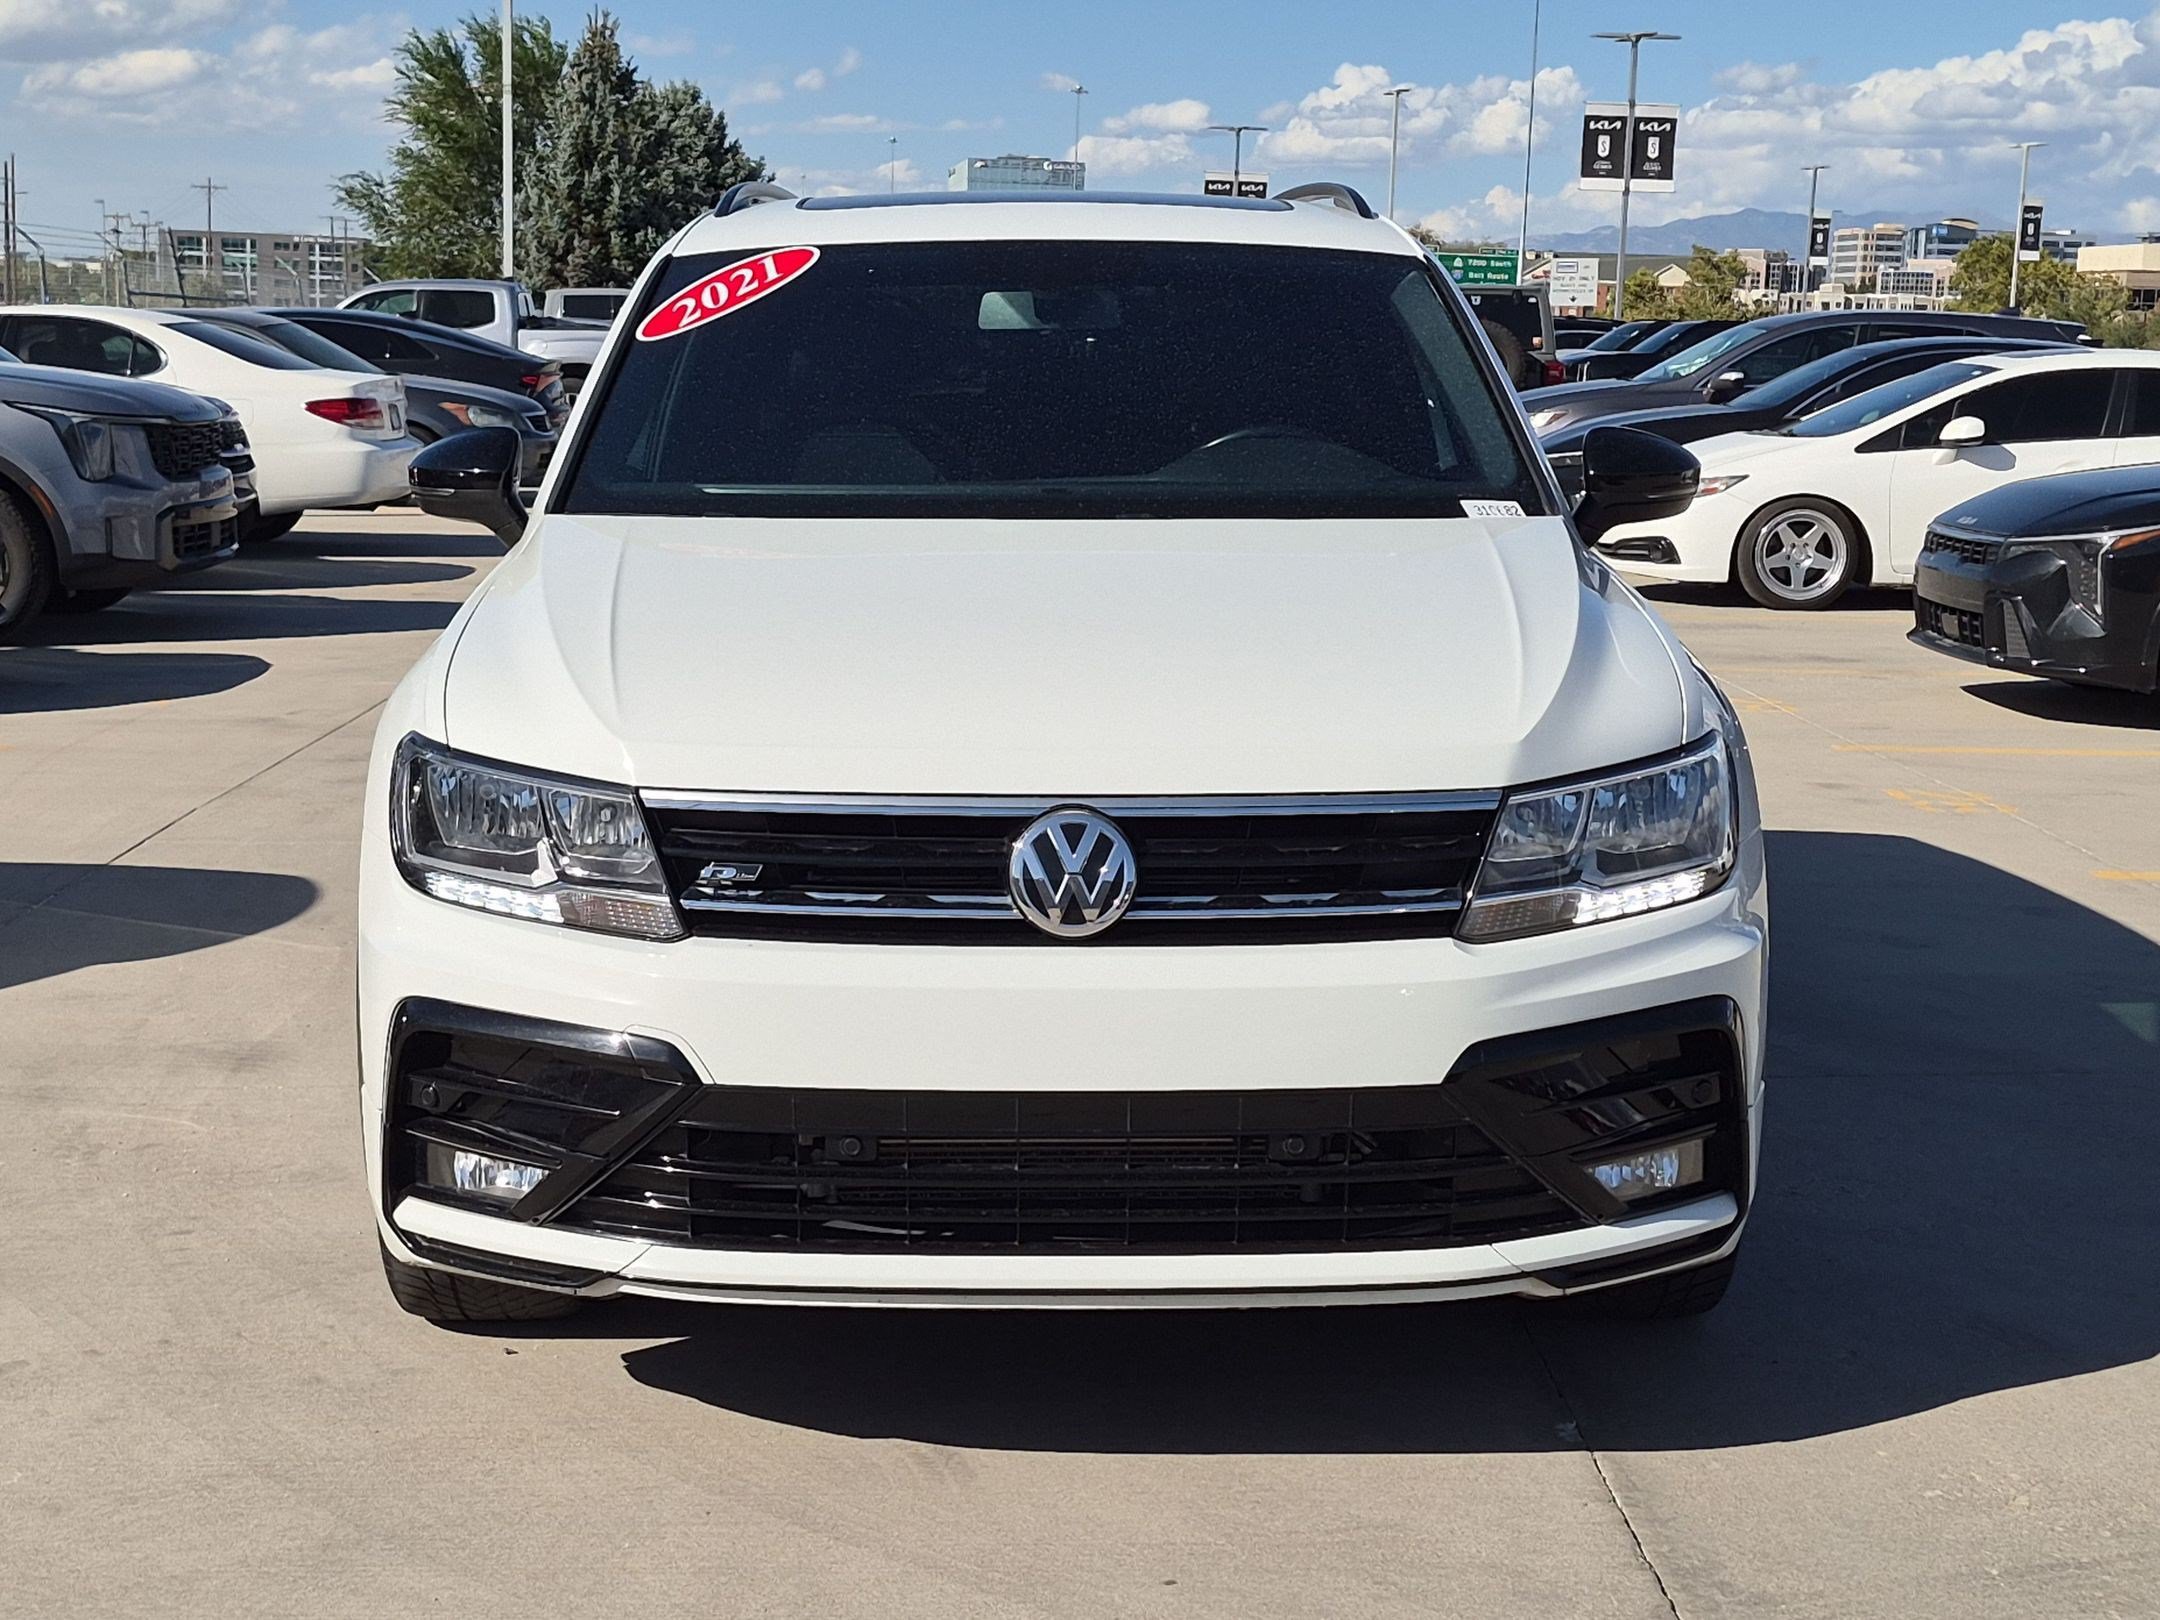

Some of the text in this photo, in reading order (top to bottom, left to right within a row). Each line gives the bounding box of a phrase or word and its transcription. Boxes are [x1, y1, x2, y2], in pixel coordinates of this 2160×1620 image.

[1589, 120, 1622, 130] KIA
[1639, 121, 1671, 132] KIA
[672, 255, 784, 328] 2021
